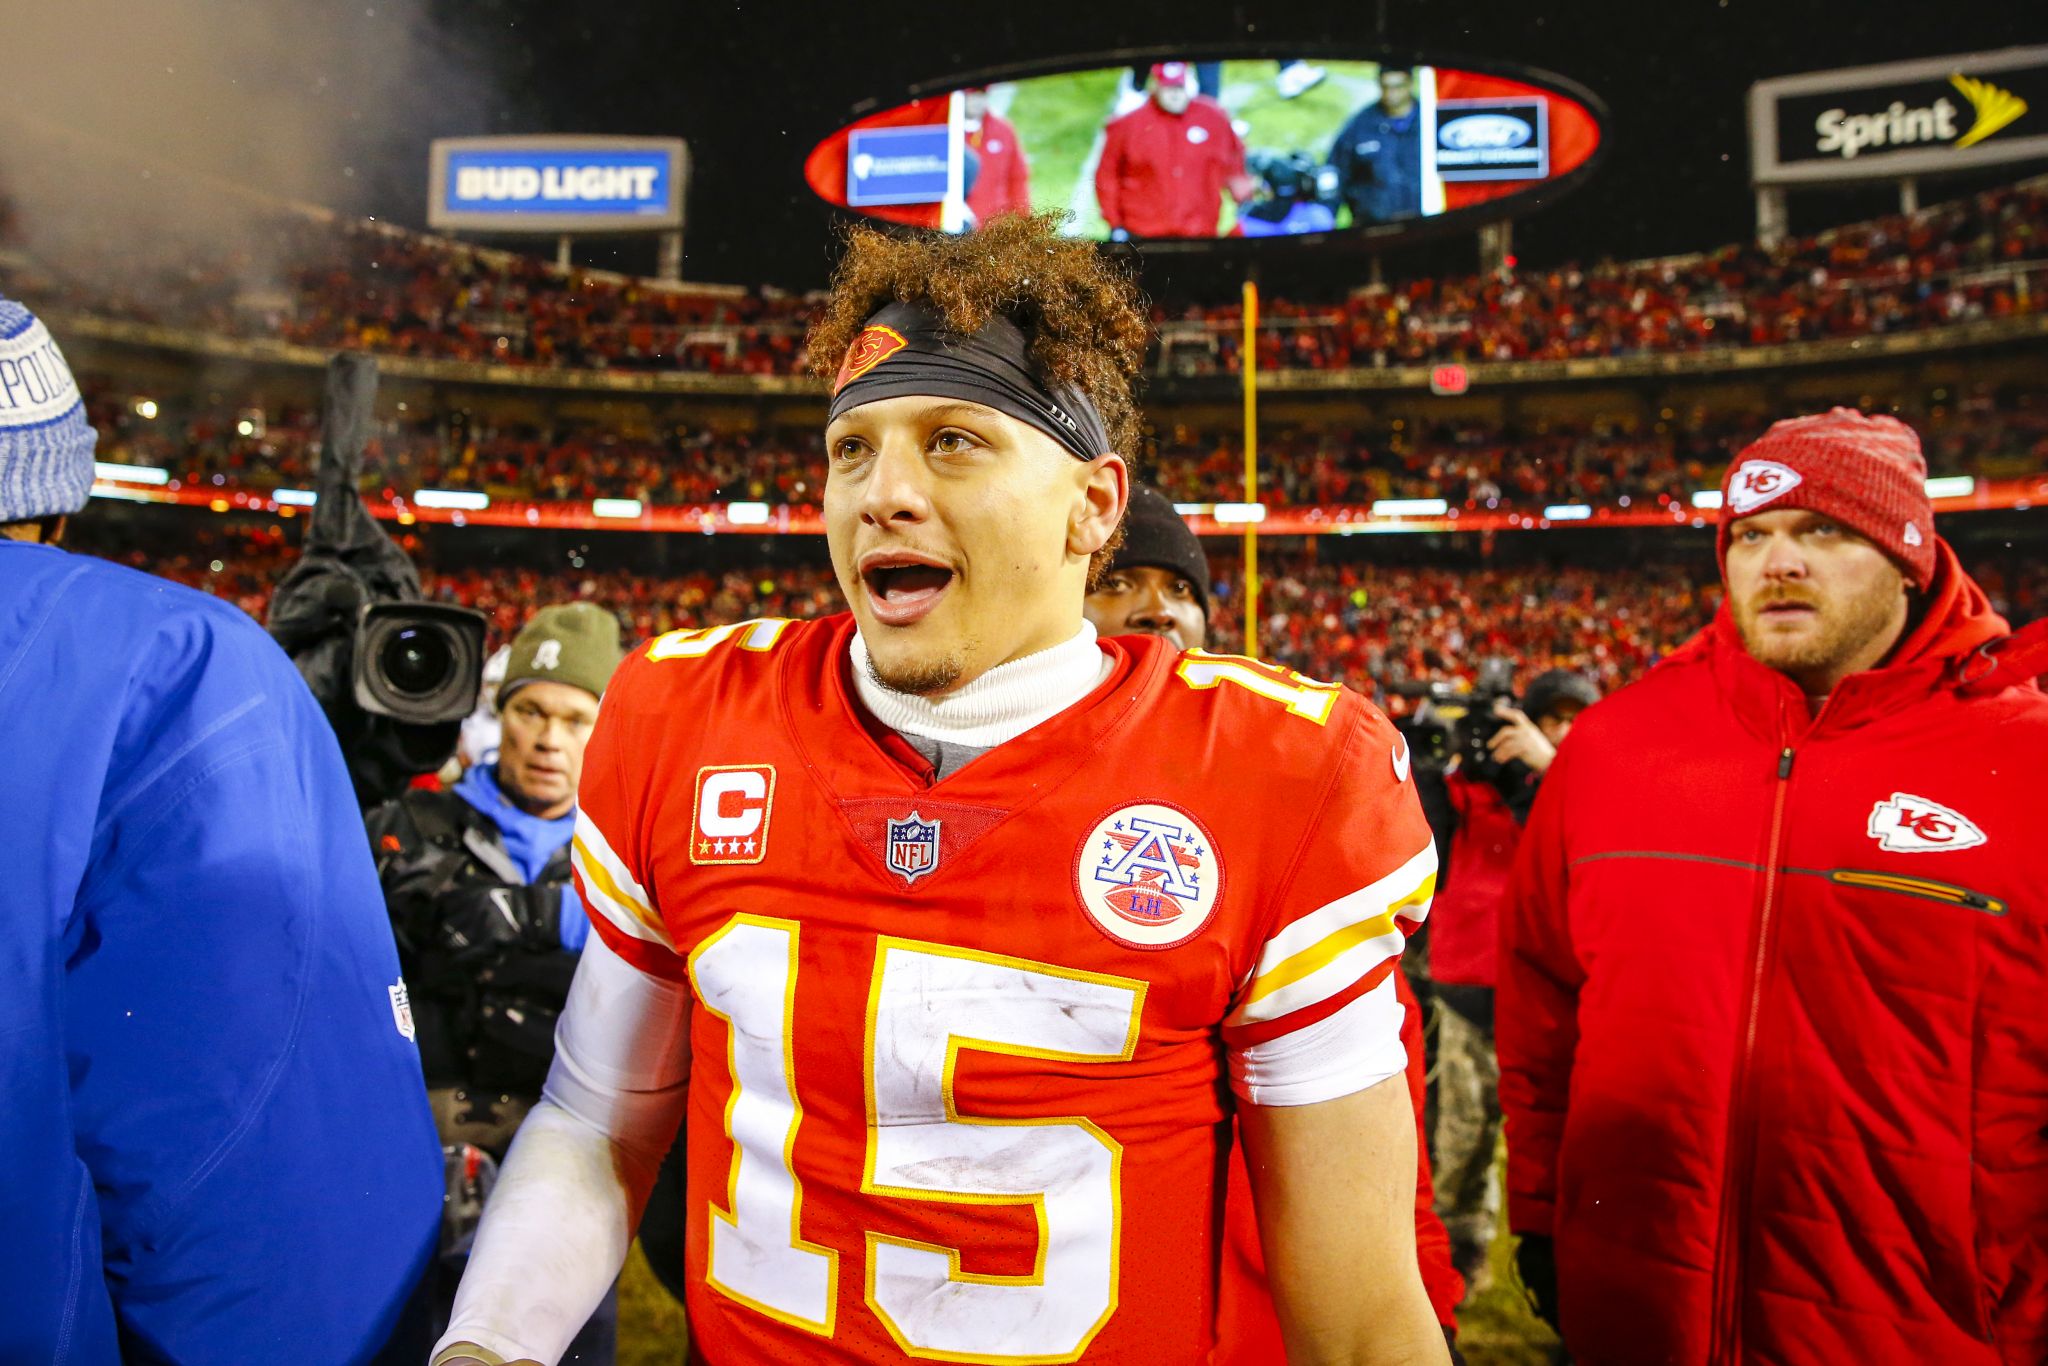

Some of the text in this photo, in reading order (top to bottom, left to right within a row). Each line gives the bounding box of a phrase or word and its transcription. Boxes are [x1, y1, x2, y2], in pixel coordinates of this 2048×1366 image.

[1815, 97, 1958, 159] Sprint
[456, 165, 658, 200] BUD LIGHT
[0, 340, 73, 410] POLIS
[699, 771, 766, 837] C
[894, 843, 929, 869] NFL
[1130, 894, 1163, 917] LH
[688, 912, 1149, 1363] 15
